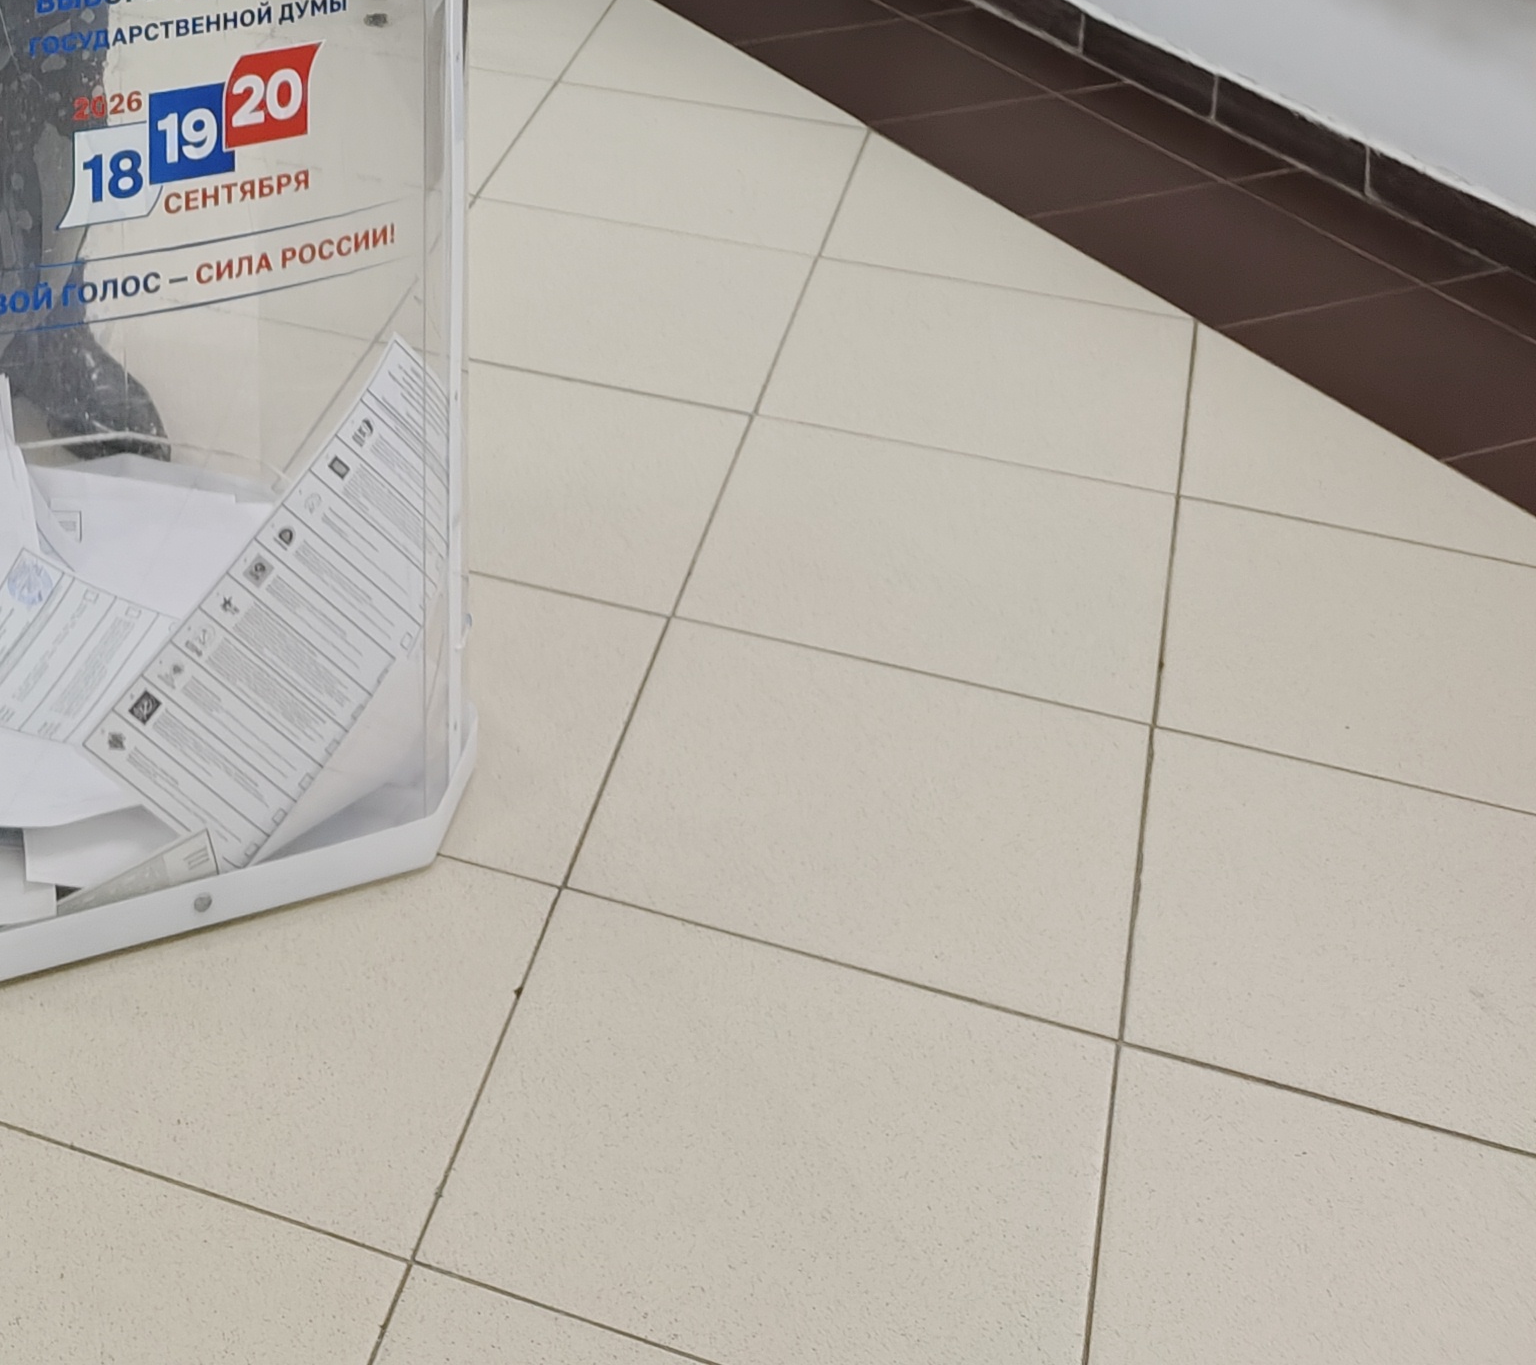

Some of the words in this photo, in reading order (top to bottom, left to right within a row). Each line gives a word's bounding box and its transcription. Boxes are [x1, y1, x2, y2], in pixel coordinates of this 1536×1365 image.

[28, 1, 273, 58] ГОСУДАРСТВЕННОЙ
[73, 89, 143, 121] 2026
[82, 148, 144, 203] 18
[157, 107, 218, 163] 19
[231, 68, 303, 128] 20
[163, 169, 311, 216] СЕНТЯБРЯ
[62, 271, 162, 306] ГОЛОС
[195, 252, 274, 285] СИЛА
[280, 222, 396, 270] РОССИИ!
